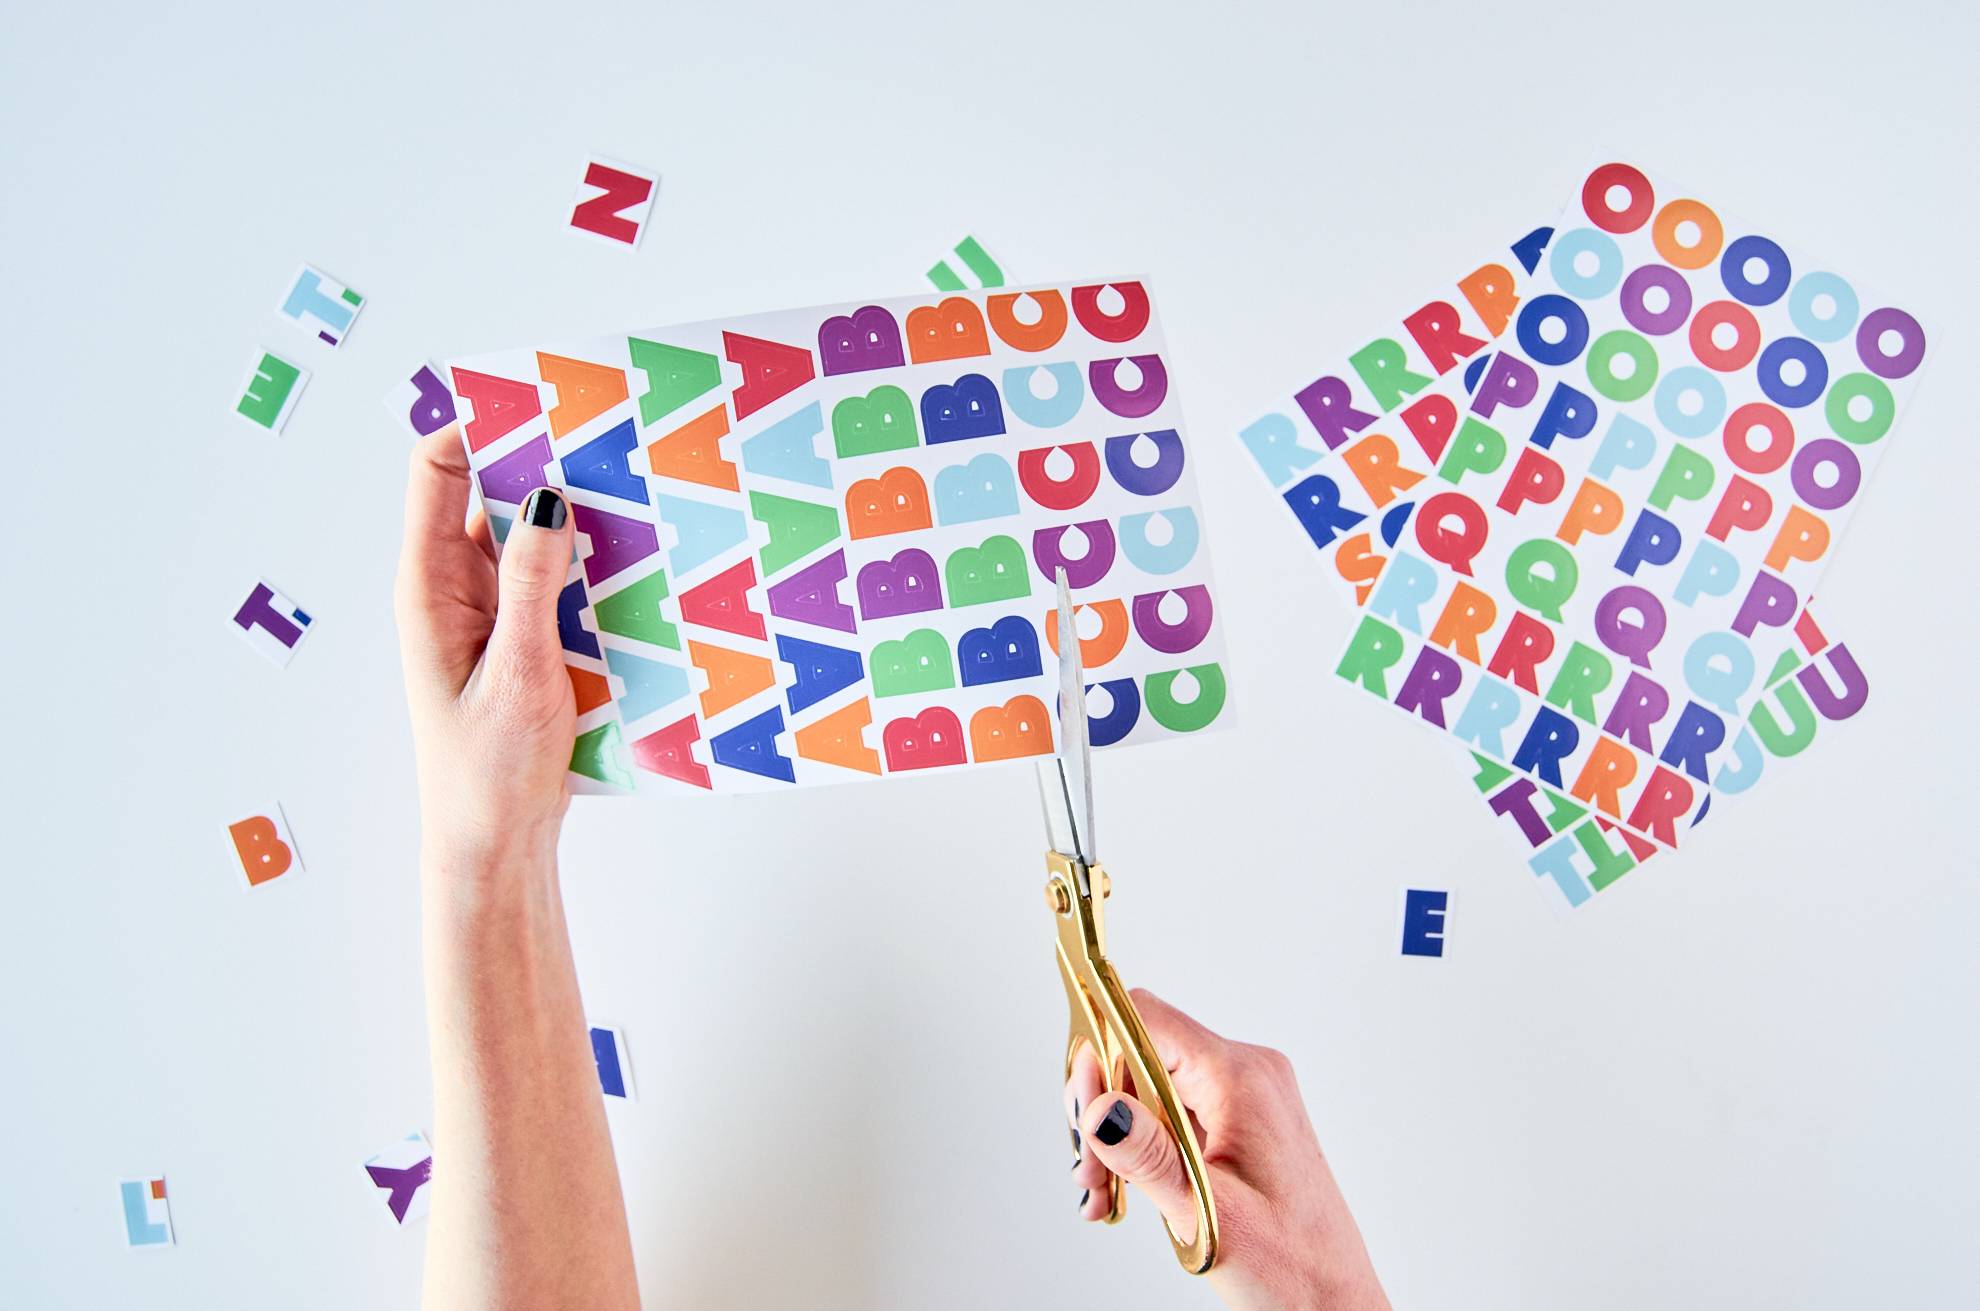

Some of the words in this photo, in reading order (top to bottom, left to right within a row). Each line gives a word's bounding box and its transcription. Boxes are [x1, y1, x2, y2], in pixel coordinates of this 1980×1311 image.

[571, 163, 652, 244] N
[283, 269, 352, 331] T
[1581, 163, 1655, 234] O
[1653, 199, 1724, 269] O
[1720, 236, 1791, 307] O
[1789, 272, 1859, 343] O
[1856, 308, 1923, 379] O
[819, 306, 905, 376] B
[906, 297, 991, 364] B
[986, 289, 1068, 352] C
[1071, 281, 1150, 343] C
[1550, 228, 1624, 299] O
[1620, 265, 1691, 335] O
[1689, 301, 1761, 372] O
[1756, 336, 1828, 408] O
[1826, 373, 1894, 444] O
[237, 353, 299, 429] E
[451, 366, 542, 454] A
[536, 353, 628, 439] A
[628, 337, 721, 427] A
[723, 331, 815, 421] A
[921, 374, 1007, 445] B
[1003, 363, 1083, 427] C
[1089, 355, 1167, 418] C
[1239, 413, 1321, 487] R
[1294, 376, 1376, 450] R
[1349, 338, 1432, 414] R
[1403, 301, 1487, 375] R
[1515, 294, 1589, 367] O
[1586, 331, 1657, 401] O
[1655, 367, 1726, 438] O
[1723, 403, 1794, 474] O
[1791, 440, 1859, 510] O
[648, 404, 739, 492] A
[742, 401, 833, 488] A
[833, 386, 918, 458] B
[561, 417, 650, 506] A
[934, 454, 1019, 526] B
[1018, 442, 1100, 510] C
[1105, 430, 1183, 495] C
[1282, 474, 1367, 549] R
[1342, 434, 1425, 508] R
[1470, 353, 1538, 419] P
[1529, 381, 1597, 450] P
[1590, 414, 1655, 480] P
[1649, 445, 1714, 510] P
[1706, 474, 1772, 541] P
[1765, 505, 1830, 572] P
[657, 494, 747, 576] A
[749, 491, 841, 576] A
[846, 467, 932, 541] B
[1119, 508, 1198, 573] C
[1439, 417, 1506, 483] P
[1497, 448, 1565, 516] P
[1557, 478, 1624, 545] P
[1614, 508, 1681, 576] P
[1673, 540, 1738, 607] P
[1732, 572, 1795, 637] P
[570, 502, 660, 588] A
[945, 536, 1031, 607] B
[1033, 520, 1115, 589] C
[236, 583, 303, 648] T
[593, 569, 680, 651] A
[679, 557, 767, 641] A
[769, 548, 856, 634] A
[857, 549, 943, 620] B
[1132, 585, 1212, 653] C
[1415, 492, 1488, 577] Q
[1506, 539, 1578, 623] Q
[1594, 586, 1666, 669] Q
[1684, 633, 1754, 714] Q
[607, 650, 690, 724] A
[688, 641, 775, 719] A
[776, 634, 864, 715] A
[870, 629, 954, 697] B
[958, 616, 1043, 687] B
[1370, 552, 1436, 633] R
[1429, 581, 1497, 665] R
[1487, 611, 1555, 696] R
[1546, 642, 1611, 725] R
[1602, 673, 1668, 754] R
[1659, 701, 1725, 783] R
[970, 695, 1054, 762] B
[1145, 664, 1225, 731] C
[1336, 616, 1403, 698] R
[1394, 645, 1460, 729] R
[1454, 677, 1519, 760] R
[1511, 705, 1579, 788] R
[1571, 737, 1638, 819] R
[1626, 765, 1694, 847] R
[1749, 681, 1816, 756] U
[1797, 644, 1867, 719] U
[633, 714, 711, 789] A
[710, 705, 795, 783] A
[795, 696, 881, 775] A
[883, 707, 967, 771] B
[1489, 778, 1550, 847] T
[229, 817, 291, 886] B
[1529, 837, 1591, 906] T
[1401, 889, 1447, 957] E
[120, 1181, 169, 1246] L
